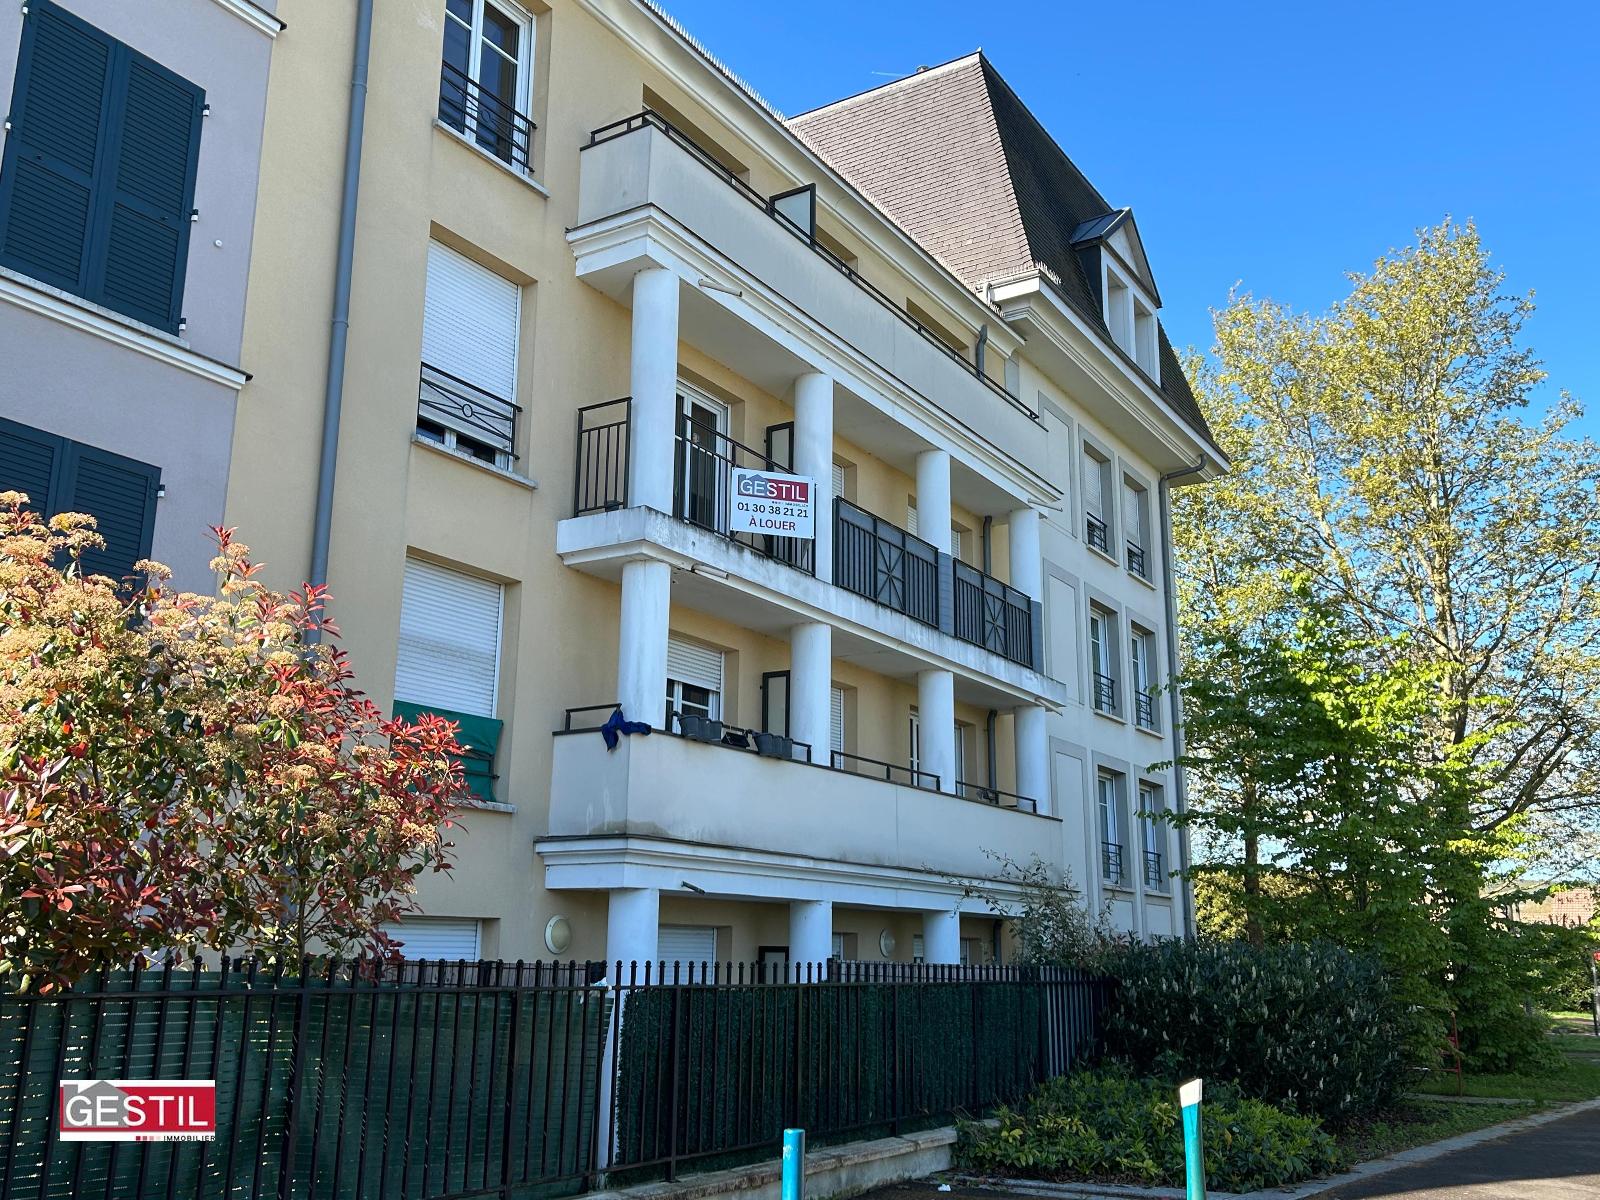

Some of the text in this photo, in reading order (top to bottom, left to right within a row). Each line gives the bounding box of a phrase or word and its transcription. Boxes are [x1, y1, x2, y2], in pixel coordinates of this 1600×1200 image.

[740, 479, 806, 501] GESTIL
[737, 501, 750, 511] 01
[752, 503, 766, 513] 30
[768, 505, 781, 515] 38
[783, 507, 795, 517] 21
[797, 508, 809, 518] 21
[749, 514, 796, 531] À LOUER
